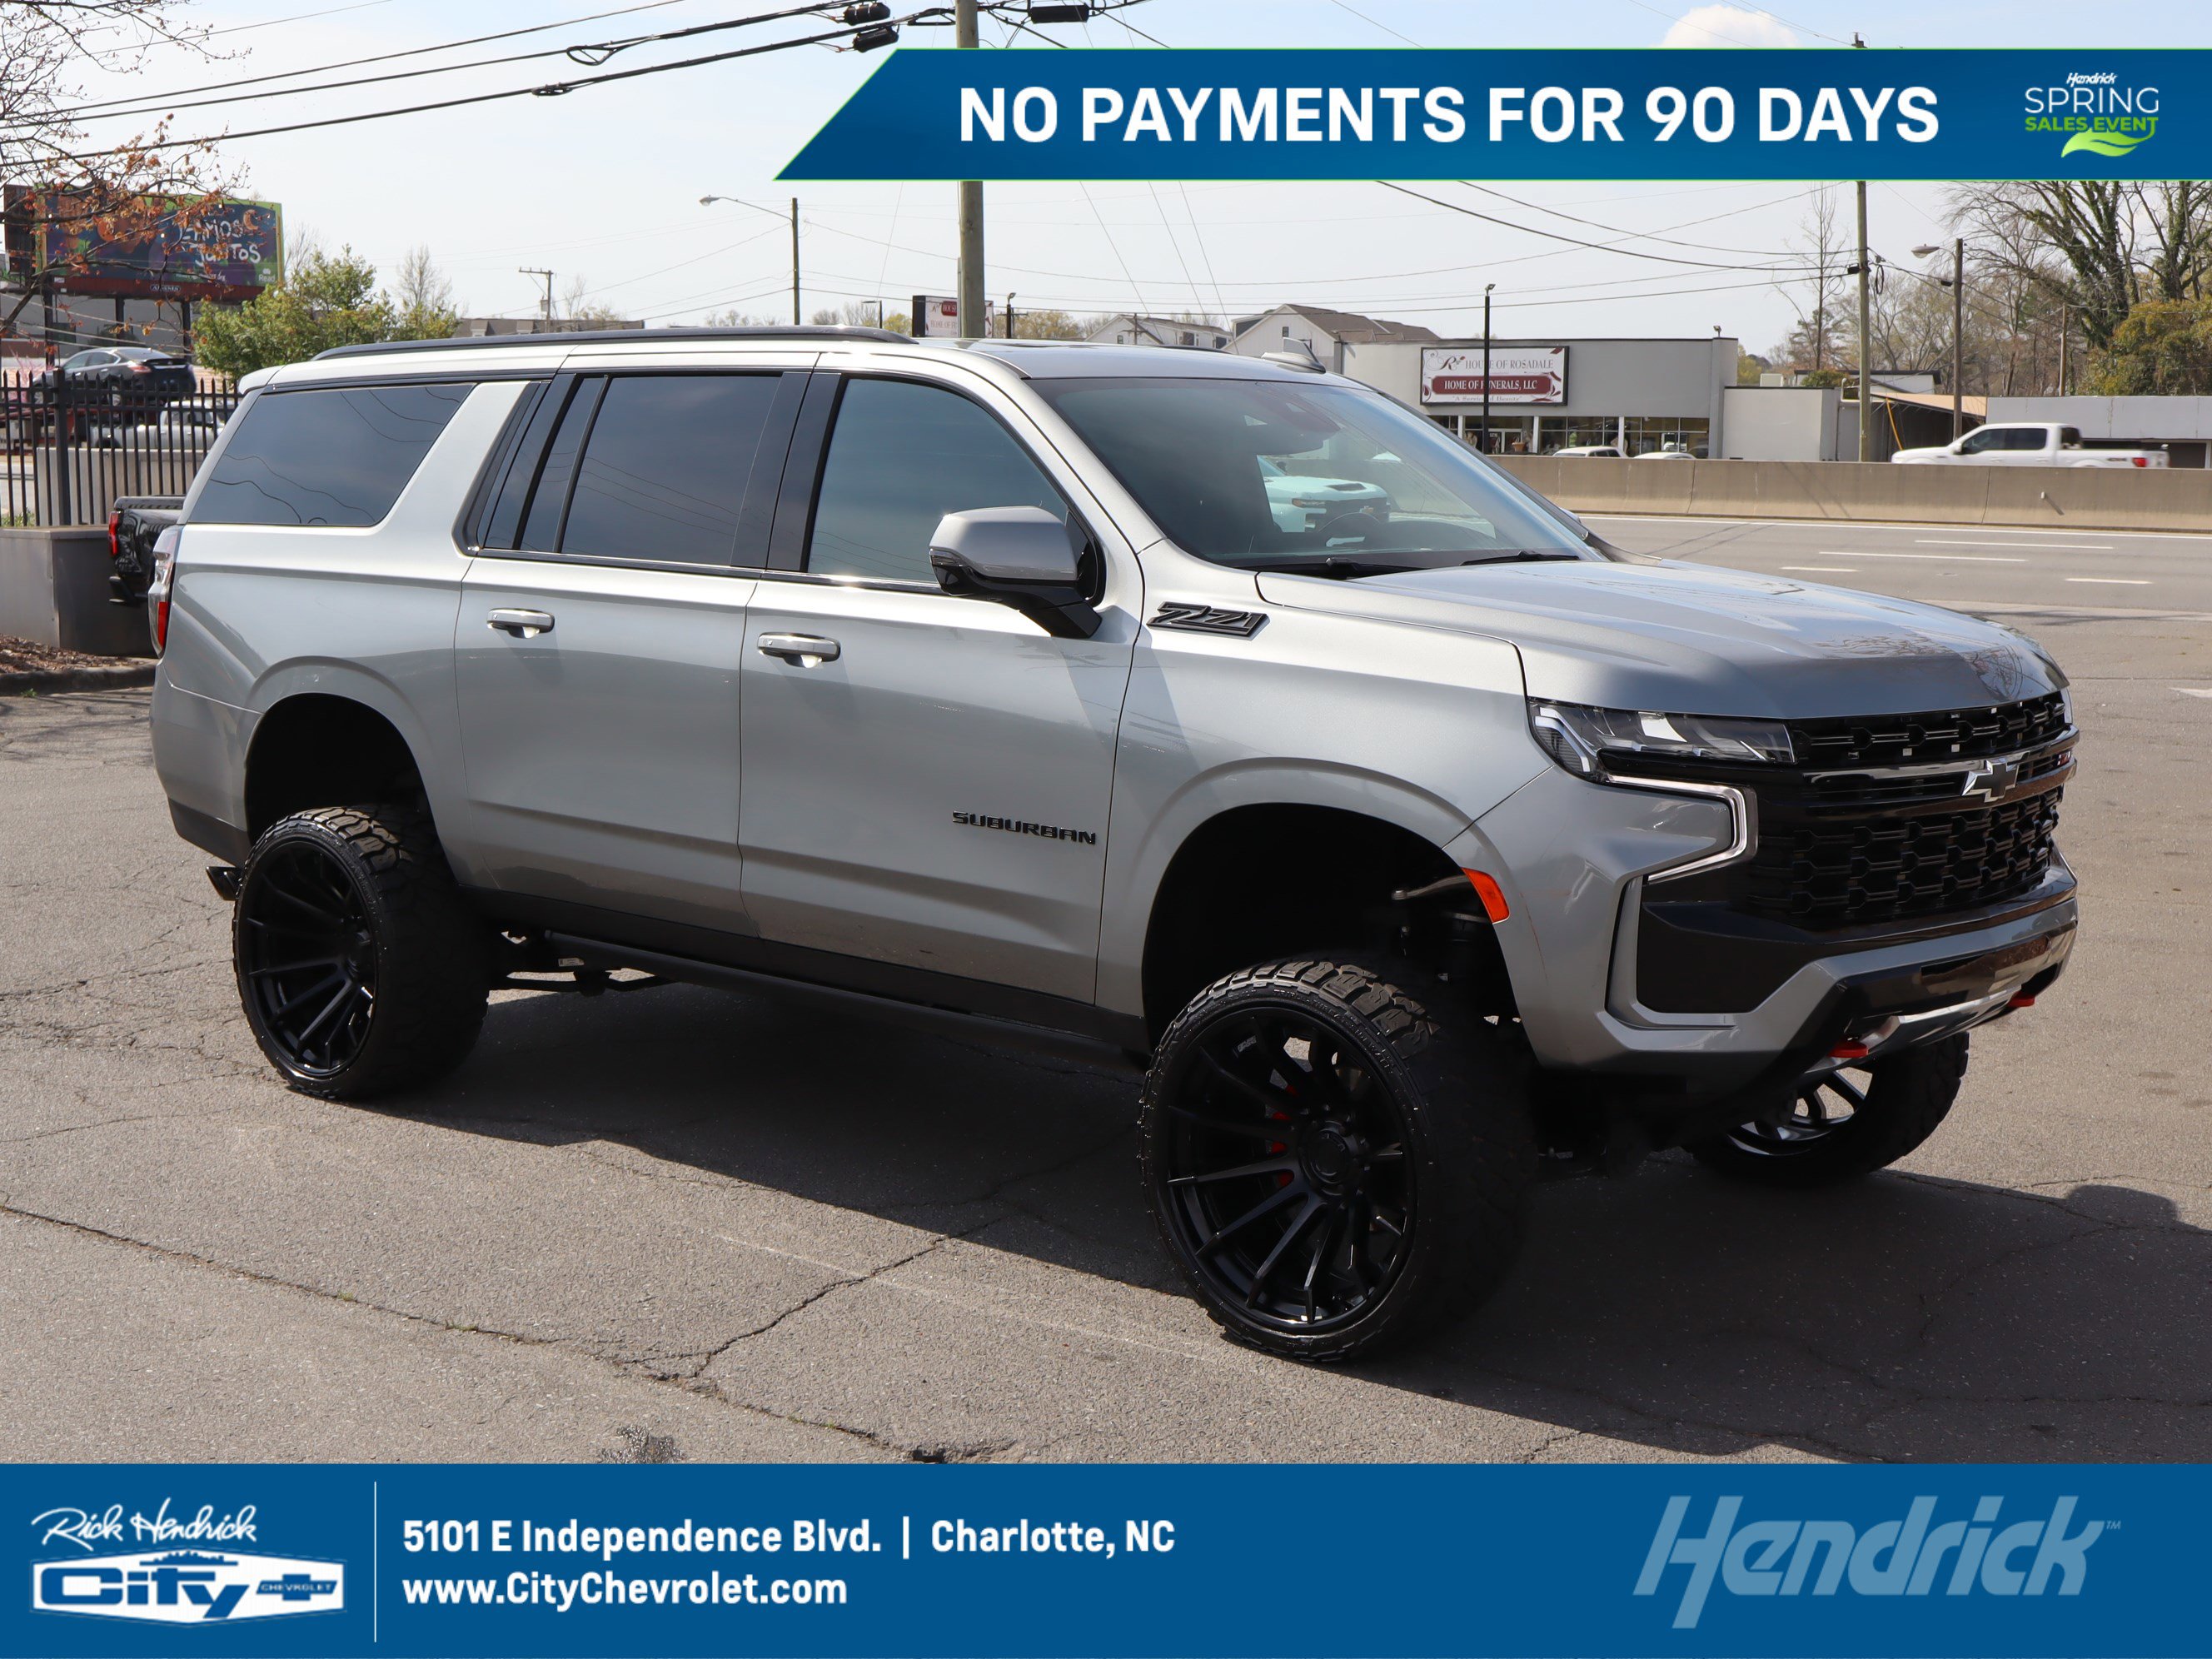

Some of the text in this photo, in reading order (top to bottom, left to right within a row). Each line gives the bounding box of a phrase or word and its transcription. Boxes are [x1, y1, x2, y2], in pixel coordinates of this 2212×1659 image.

[258, 274, 276, 282] Read
[1465, 359, 1554, 370] HOUE OF ROSADALE
[1444, 380, 1537, 391] HOME OF FNERALS, LLC
[1146, 601, 1269, 639] Z71
[952, 810, 1097, 845] SUBURBAN
